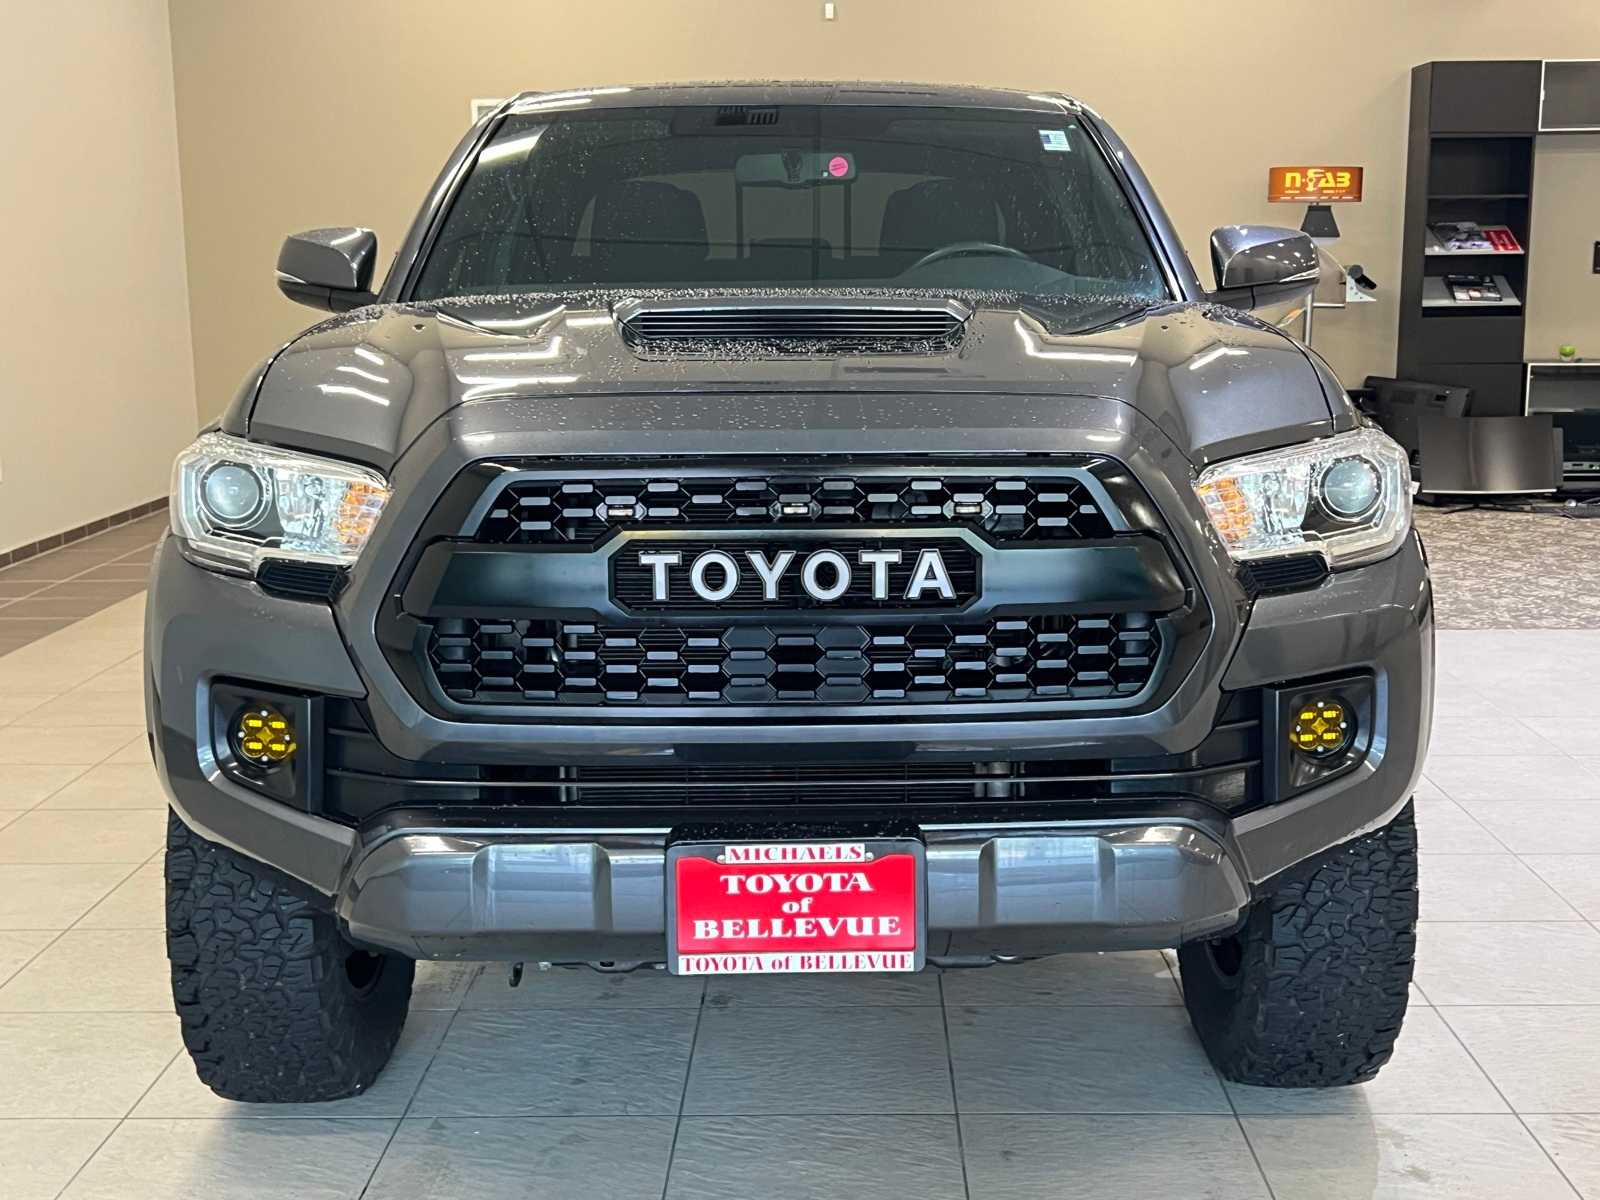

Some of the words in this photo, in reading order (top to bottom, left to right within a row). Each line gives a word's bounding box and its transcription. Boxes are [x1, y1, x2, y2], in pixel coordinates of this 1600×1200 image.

[638, 549, 956, 601] TOYOTA
[728, 845, 863, 861] MICHAELS
[719, 872, 874, 895] TOYOTA
[781, 897, 813, 914] of
[693, 916, 901, 940] BELLEVUE
[681, 956, 764, 972] TOYOTA
[771, 955, 793, 971] of
[800, 954, 912, 970] BELLEVUE
